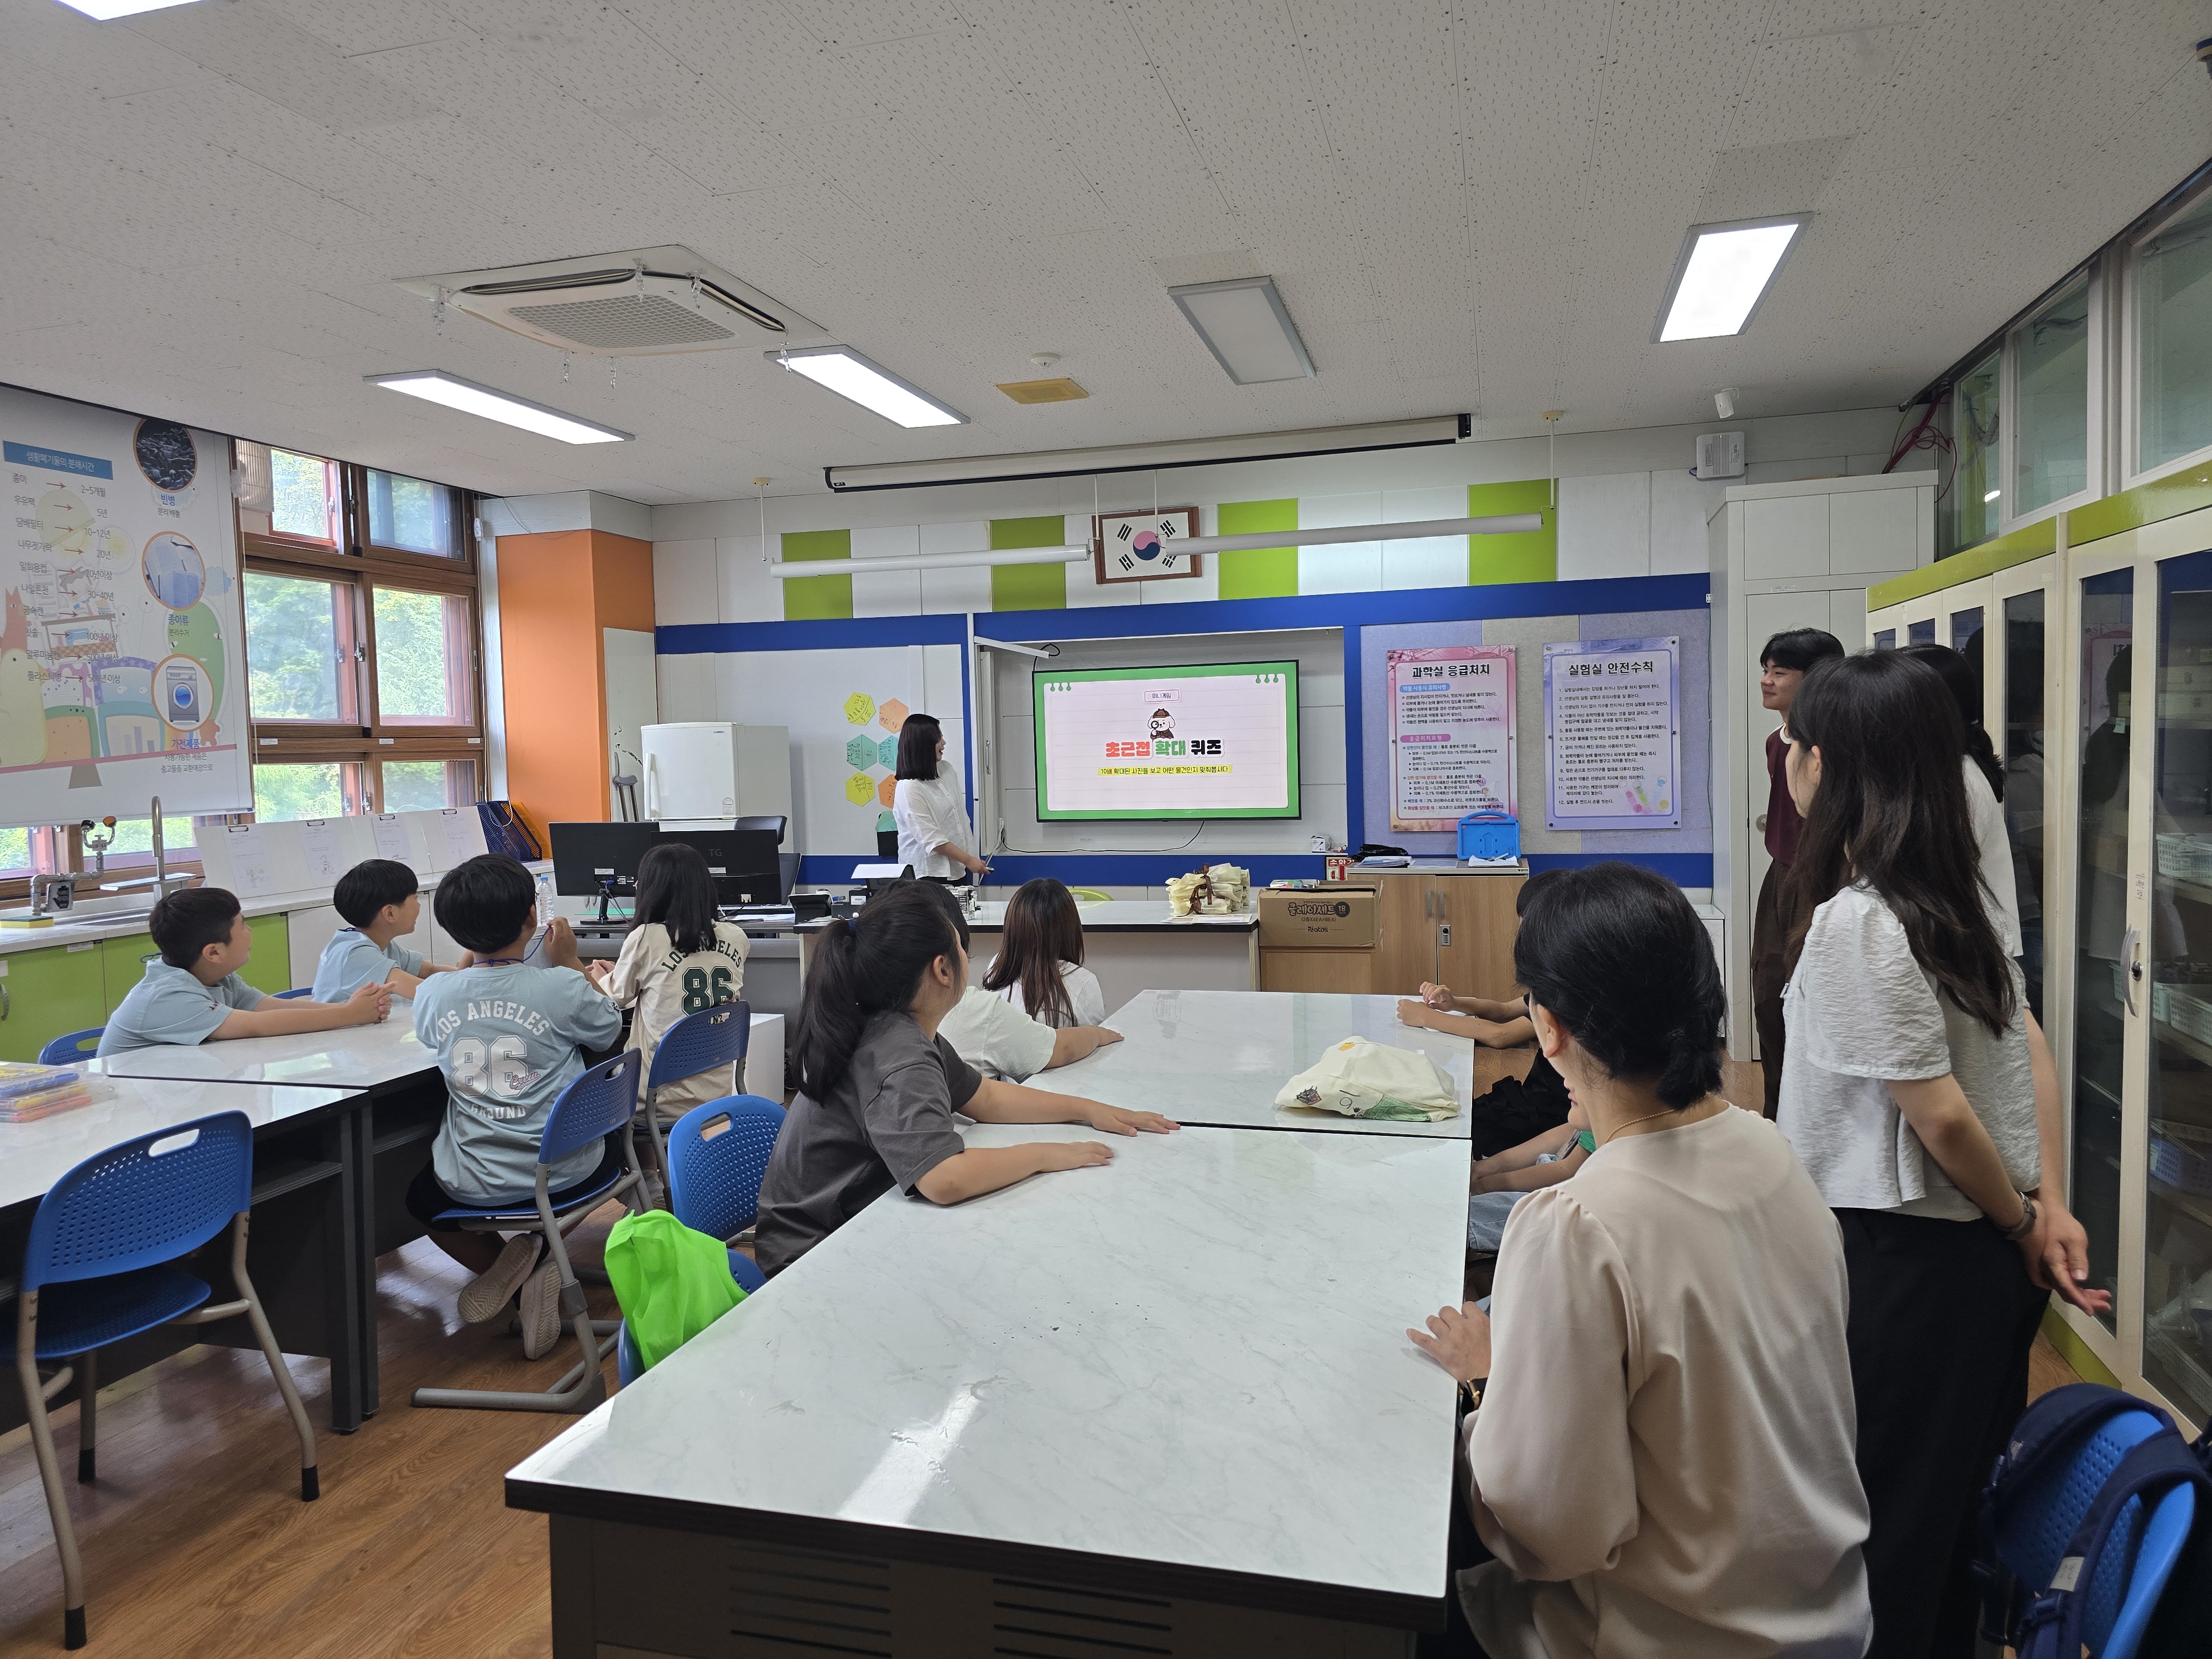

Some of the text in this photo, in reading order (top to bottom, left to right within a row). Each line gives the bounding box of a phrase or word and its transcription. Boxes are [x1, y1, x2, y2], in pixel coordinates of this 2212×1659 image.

[27, 451, 94, 472] 생활폐기물의 분해시간
[13, 473, 106, 497] 종이 2~5개월
[14, 495, 107, 518] 우유팩 5년
[161, 494, 175, 506] 빈병
[16, 518, 110, 539] 담배필터 10~12년
[18, 540, 111, 560] 나무젓가락 20년
[86, 570, 112, 580] 20년이상
[88, 591, 113, 601] 30~40년
[23, 606, 116, 622] 금속캔 100년
[168, 614, 189, 626] 종이류
[25, 628, 118, 642] 칫솔 100년 이상
[169, 628, 189, 637] 분리수거
[27, 650, 119, 662] 알루미늄캔 500년 이상
[1412, 664, 1490, 677] 과학실 응급처치
[1568, 661, 1653, 675] 실험실 안전수칙
[28, 671, 61, 682] 플라스틱병
[108, 675, 121, 684] 이상
[171, 739, 200, 749] 가전제품
[1105, 739, 1222, 757] 초근접 확대 퀴즈
[165, 753, 191, 761] 사용가능한
[1288, 902, 1335, 916] 클레이세트
[681, 966, 735, 1016] 86
[436, 1000, 550, 1042] LOS ANGELES
[451, 1035, 528, 1098] 86
[509, 1071, 541, 1091] Crew
[471, 1103, 526, 1119] GROUND
